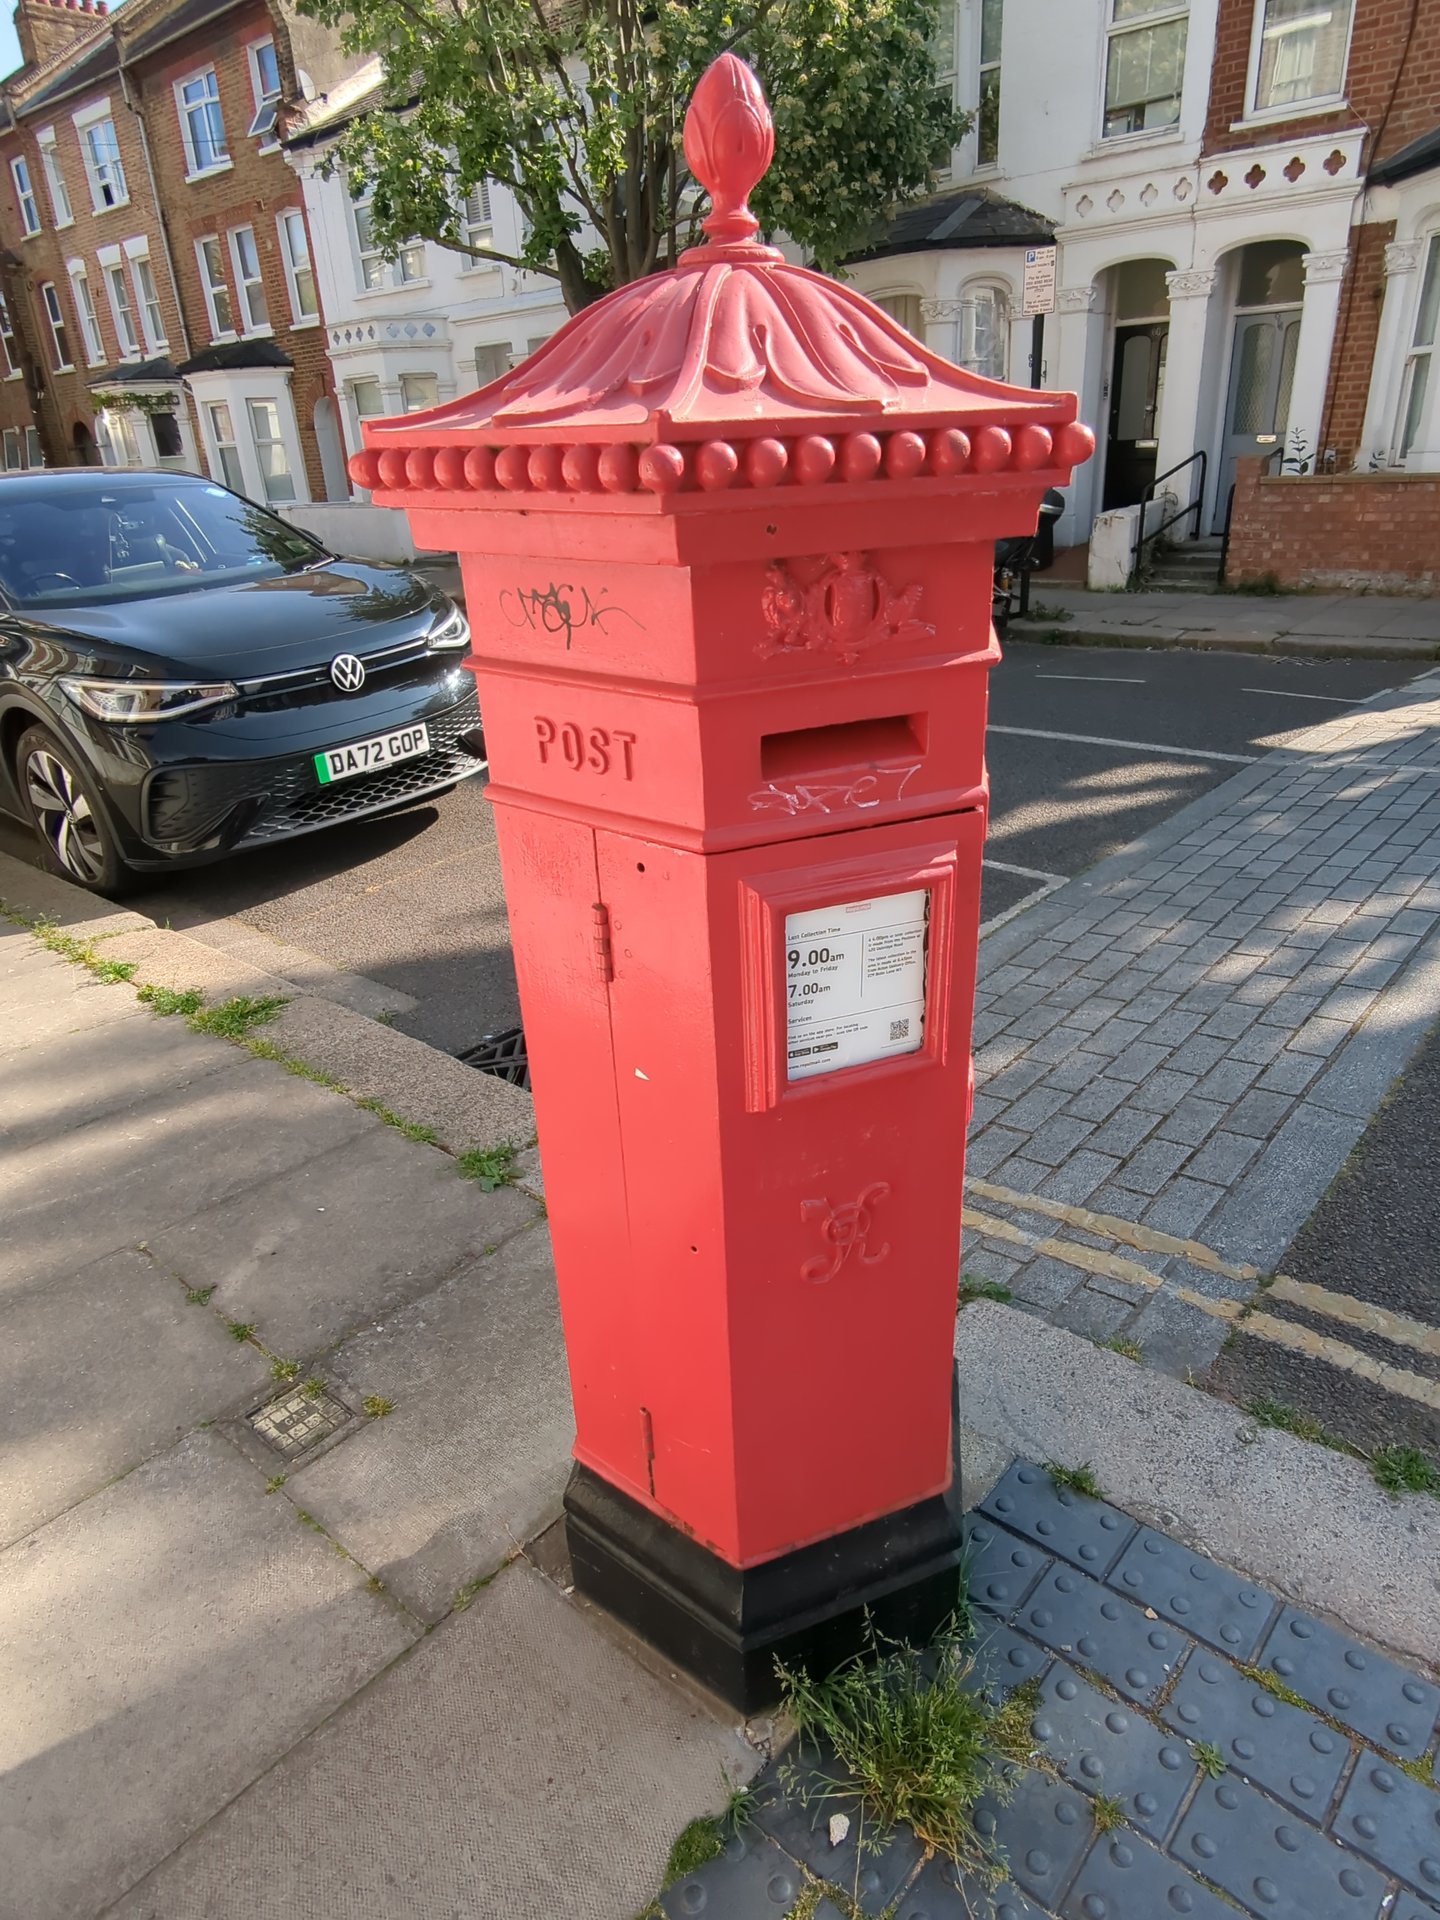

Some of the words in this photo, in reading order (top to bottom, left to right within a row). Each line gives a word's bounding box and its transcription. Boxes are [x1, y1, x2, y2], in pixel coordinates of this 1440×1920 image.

[329, 741, 385, 775] DA72
[388, 729, 424, 758] GOP
[533, 714, 637, 782] POST
[787, 933, 800, 941] Last
[800, 930, 827, 939] Collection
[787, 947, 845, 969] 9.00am
[787, 969, 811, 979] Monday
[820, 964, 839, 973] Friday
[787, 982, 831, 998] 7.00am
[787, 999, 814, 1008] Saturday
[787, 1015, 813, 1025] Services
